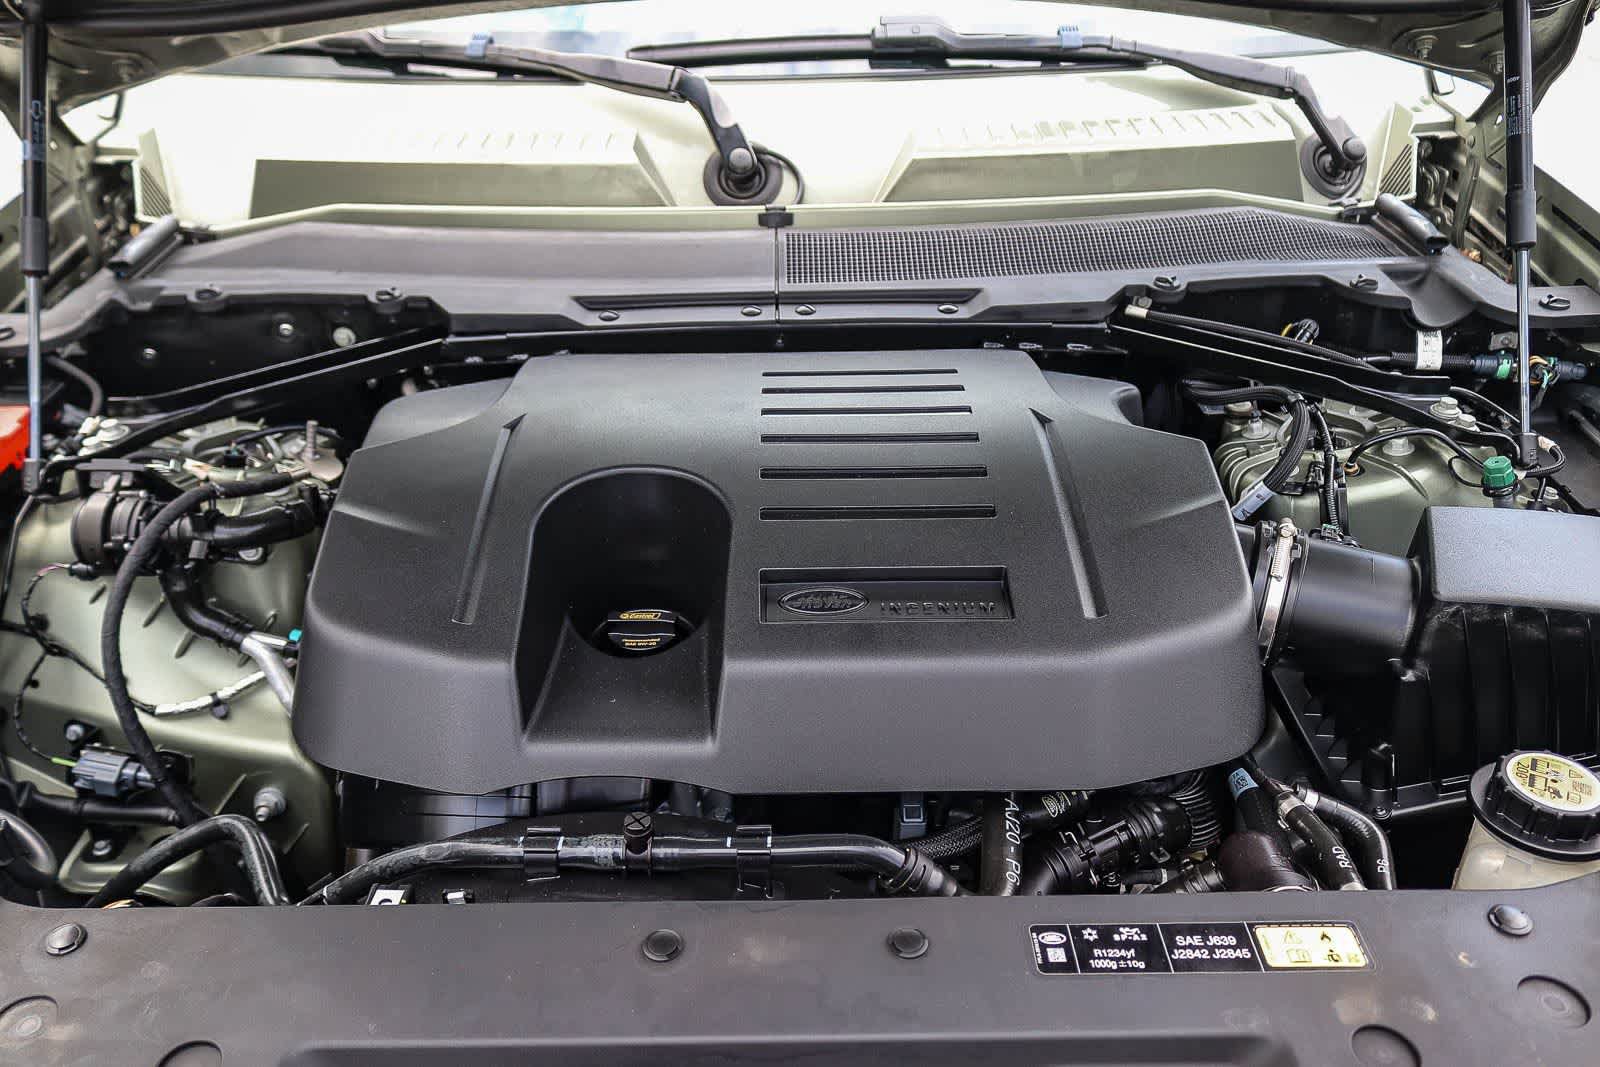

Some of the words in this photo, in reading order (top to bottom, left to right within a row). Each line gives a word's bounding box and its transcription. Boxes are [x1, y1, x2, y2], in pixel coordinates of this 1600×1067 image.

[880, 600, 996, 616] INGENIUM
[1004, 798, 1021, 845] AJ20
[1331, 846, 1353, 869] RAD
[1005, 857, 1021, 887] P6
[1175, 936, 1204, 946] SAE
[1206, 935, 1237, 946] J639
[1093, 948, 1136, 959] R1234yf
[1171, 949, 1211, 960] J2842
[1212, 948, 1252, 959] J2845
[1089, 959, 1118, 970] 1000g
[1119, 959, 1146, 970] ±10g
